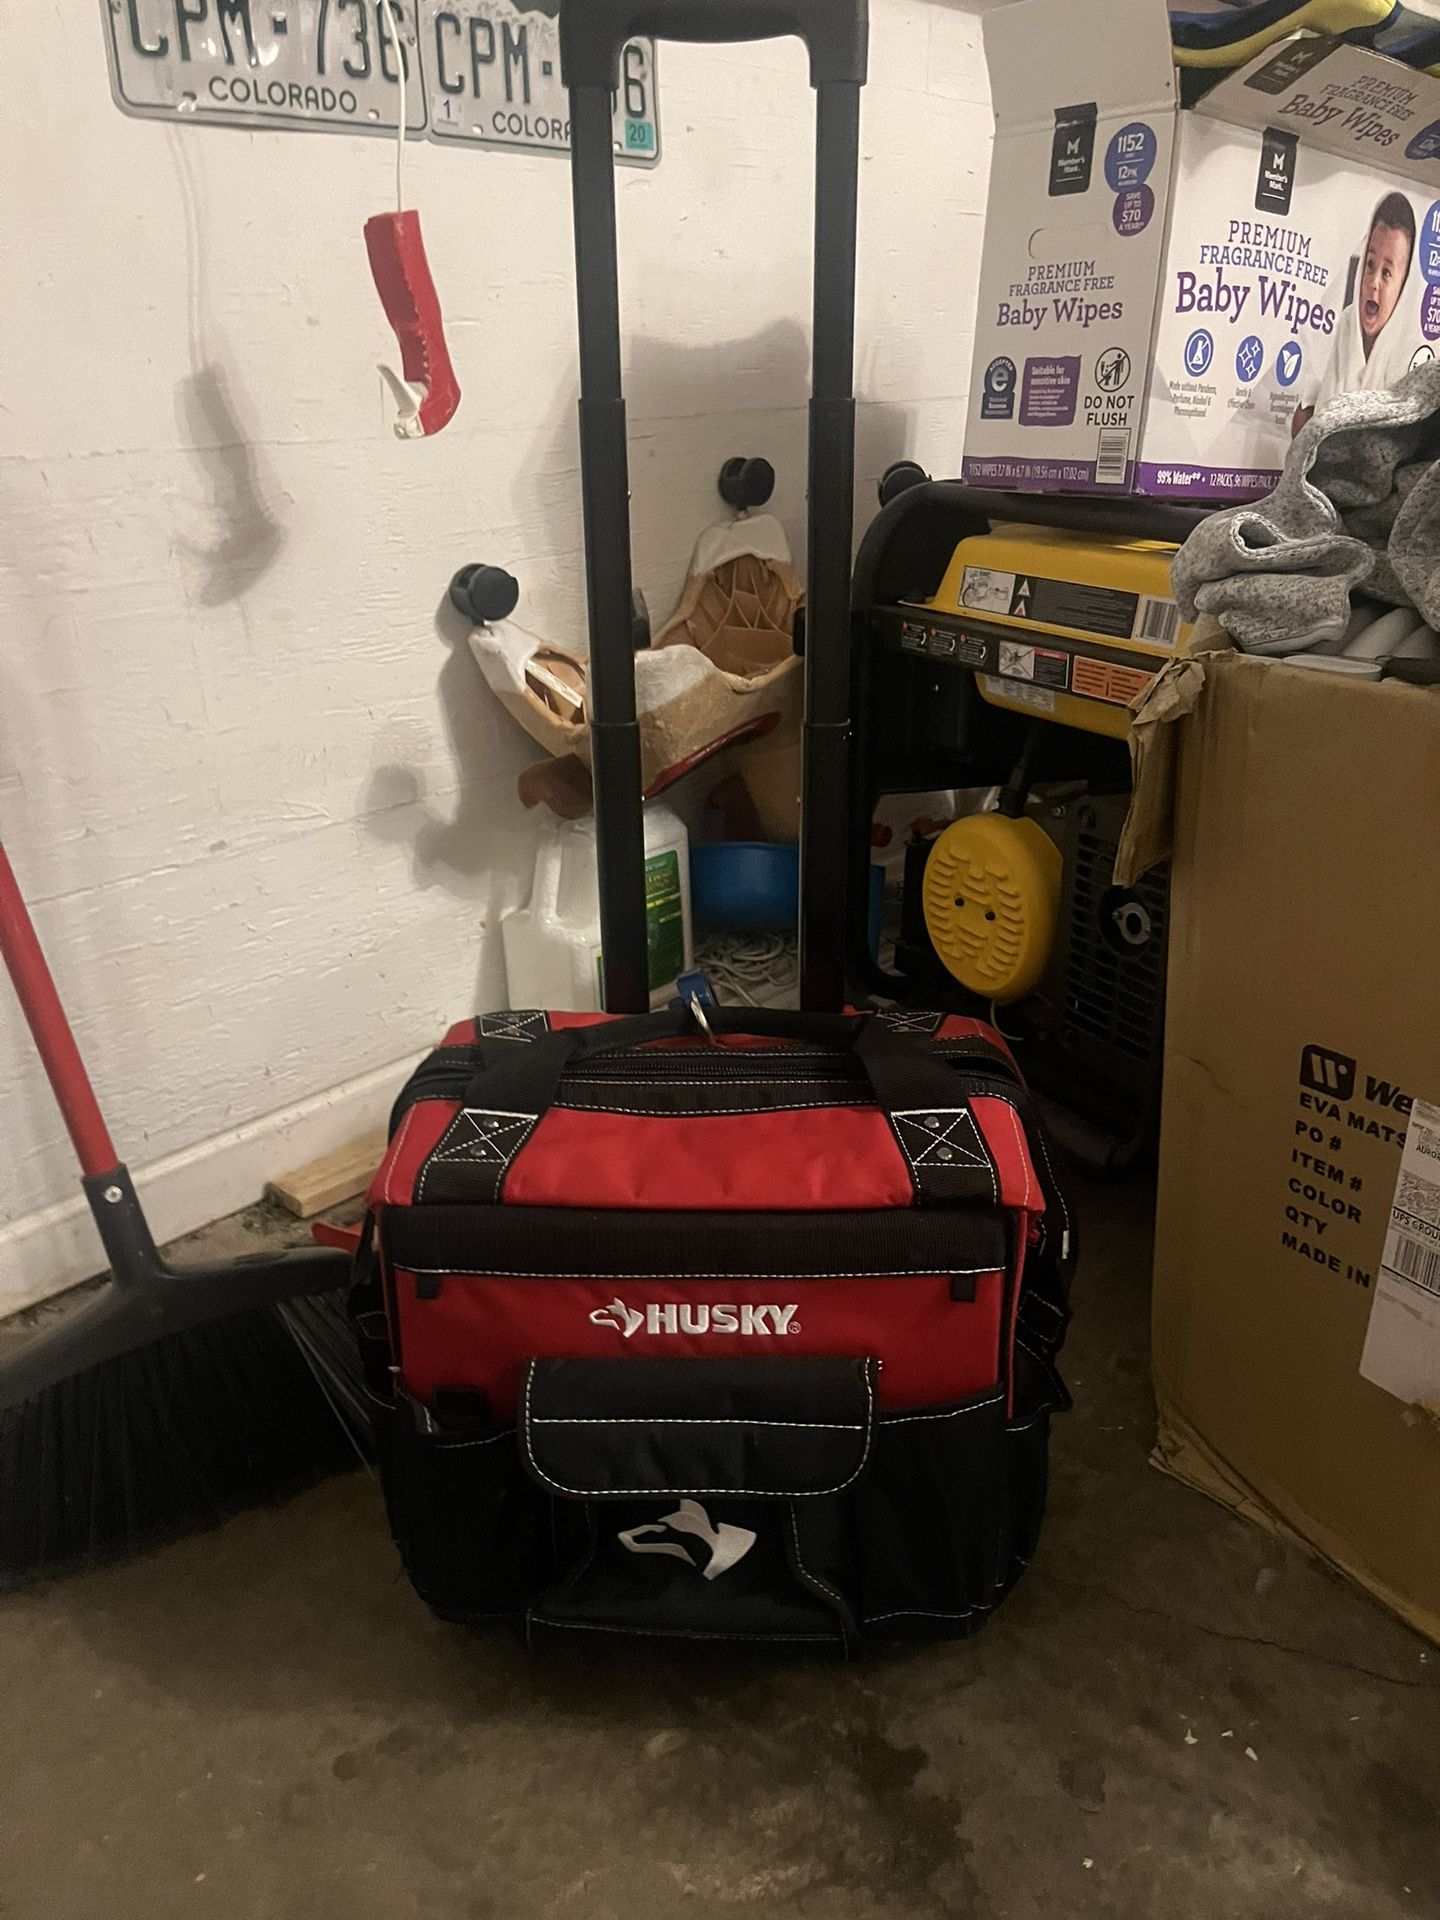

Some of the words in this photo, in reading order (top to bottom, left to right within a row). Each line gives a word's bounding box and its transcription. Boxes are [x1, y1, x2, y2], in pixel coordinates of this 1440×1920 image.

[209, 75, 357, 113] COLORADO
[1320, 84, 1394, 111] FRAGRANCE
[1351, 75, 1419, 105] PREMIUM
[492, 111, 571, 141] COLORA
[628, 124, 646, 142] 20
[1278, 94, 1344, 126] Baby
[1341, 107, 1401, 146] Wipes
[1117, 133, 1145, 154] 1152
[1126, 191, 1141, 201] SAVE
[1228, 220, 1311, 258] PREMIUM
[1028, 260, 1096, 281] PREMIUM
[1199, 245, 1292, 275] FRAGRANCE
[1295, 260, 1328, 287] FREE
[1009, 278, 1080, 297] FRAGRANCE
[1084, 276, 1115, 290] FREE
[1175, 267, 1250, 324] Baby
[1258, 276, 1336, 335] Wipes
[996, 299, 1048, 330] Baby
[1053, 297, 1123, 328] Wipes
[1084, 395, 1104, 409] DO
[1106, 395, 1134, 409] NOT
[1086, 412, 1127, 426] FLUSH
[1156, 470, 1173, 485] 99%
[1295, 1120, 1324, 1144] PO
[1329, 1135, 1343, 1152] #
[1299, 1091, 1342, 1122] EVA
[1346, 1111, 1407, 1149] MATS
[1292, 1148, 1345, 1184] ITEM
[1349, 1175, 1363, 1193] #
[1287, 1177, 1363, 1223] COLOR
[1284, 1204, 1328, 1236] QTY
[1393, 1208, 1410, 1226] UPS
[1281, 1231, 1342, 1274] MADE
[1346, 1264, 1372, 1288] IN
[646, 1303, 799, 1335] HUSKY
